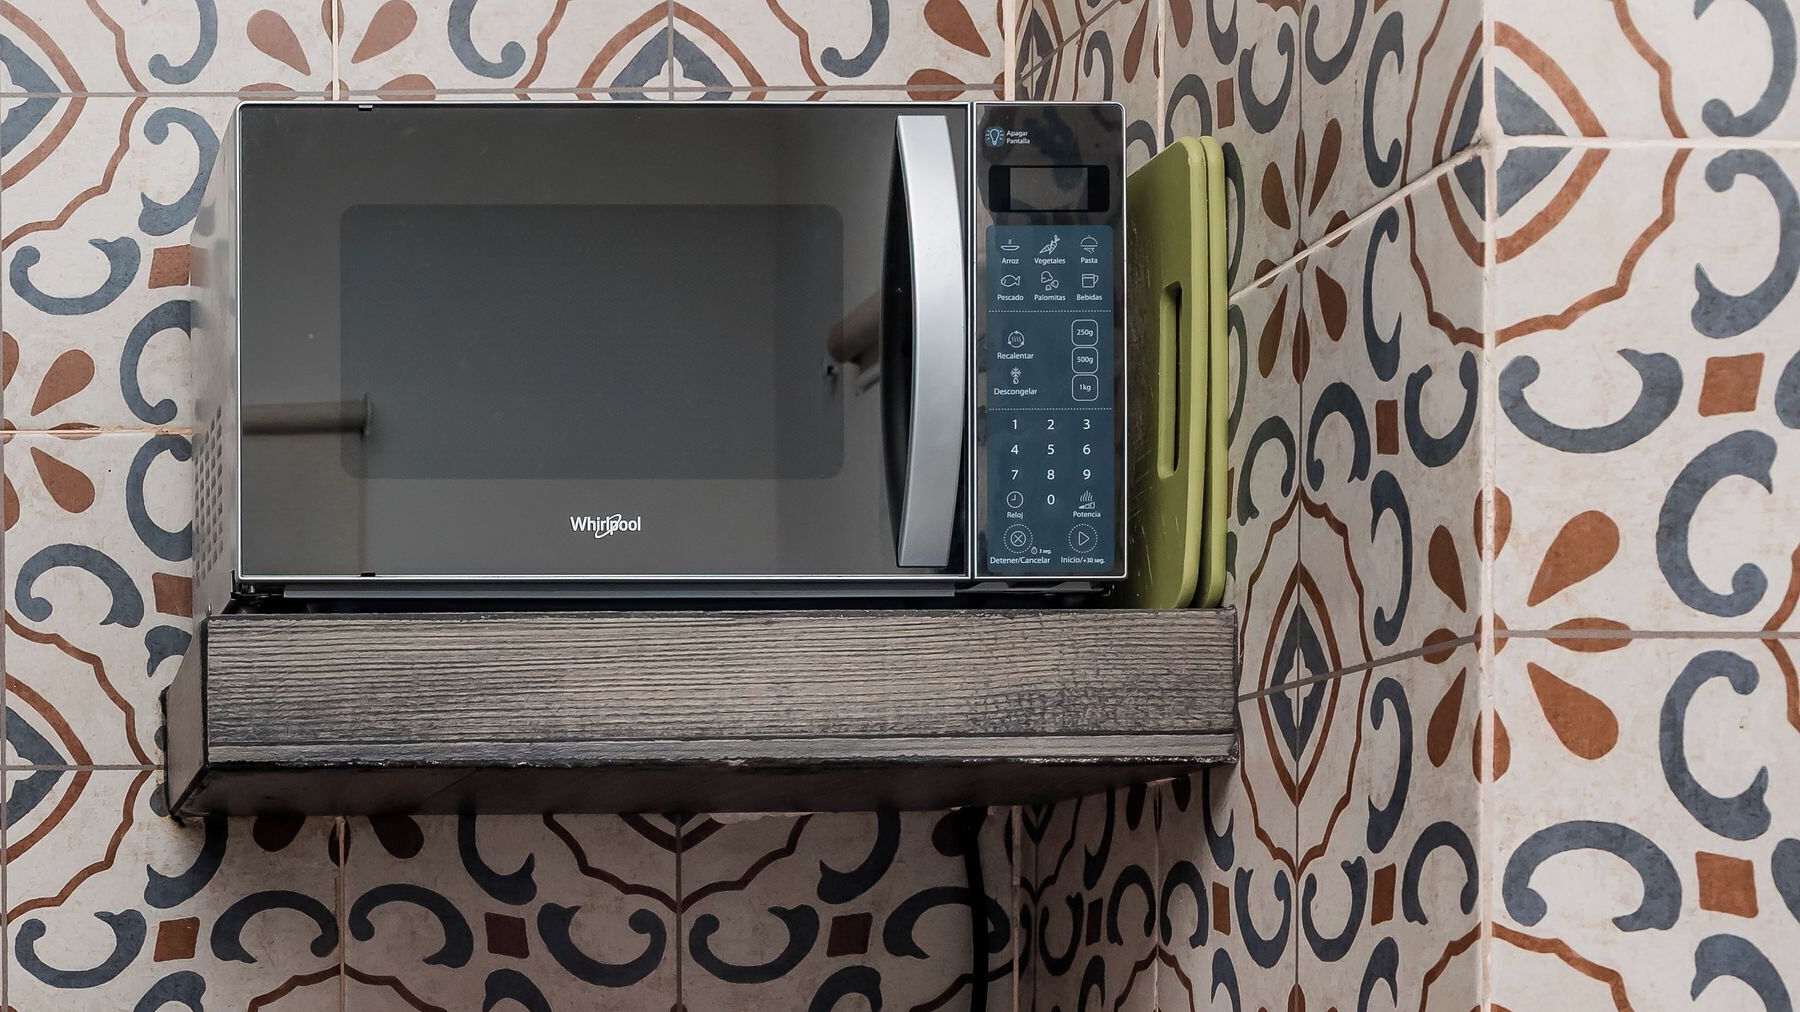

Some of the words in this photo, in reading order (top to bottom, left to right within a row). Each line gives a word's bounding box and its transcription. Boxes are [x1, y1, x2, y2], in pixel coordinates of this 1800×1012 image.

[1006, 130, 1028, 138] Apagar
[1034, 257, 1066, 265] Vegetales
[997, 352, 1034, 360] Recalentar
[1077, 356, 1093, 364] 500g
[994, 388, 1037, 396] Descongelar
[1012, 419, 1018, 430] 1
[1047, 419, 1054, 430] 2
[1083, 419, 1090, 430] 3
[1011, 444, 1019, 455] 4
[1047, 444, 1054, 455] 5
[1083, 444, 1090, 455] 6
[1012, 470, 1019, 480] 7
[1047, 470, 1054, 480] 8
[1083, 470, 1090, 480] 9
[1047, 494, 1054, 505] 0
[1007, 511, 1023, 519] Reloj
[570, 514, 641, 538] Whirlpool
[990, 556, 1050, 564] Detener/Cancelar
